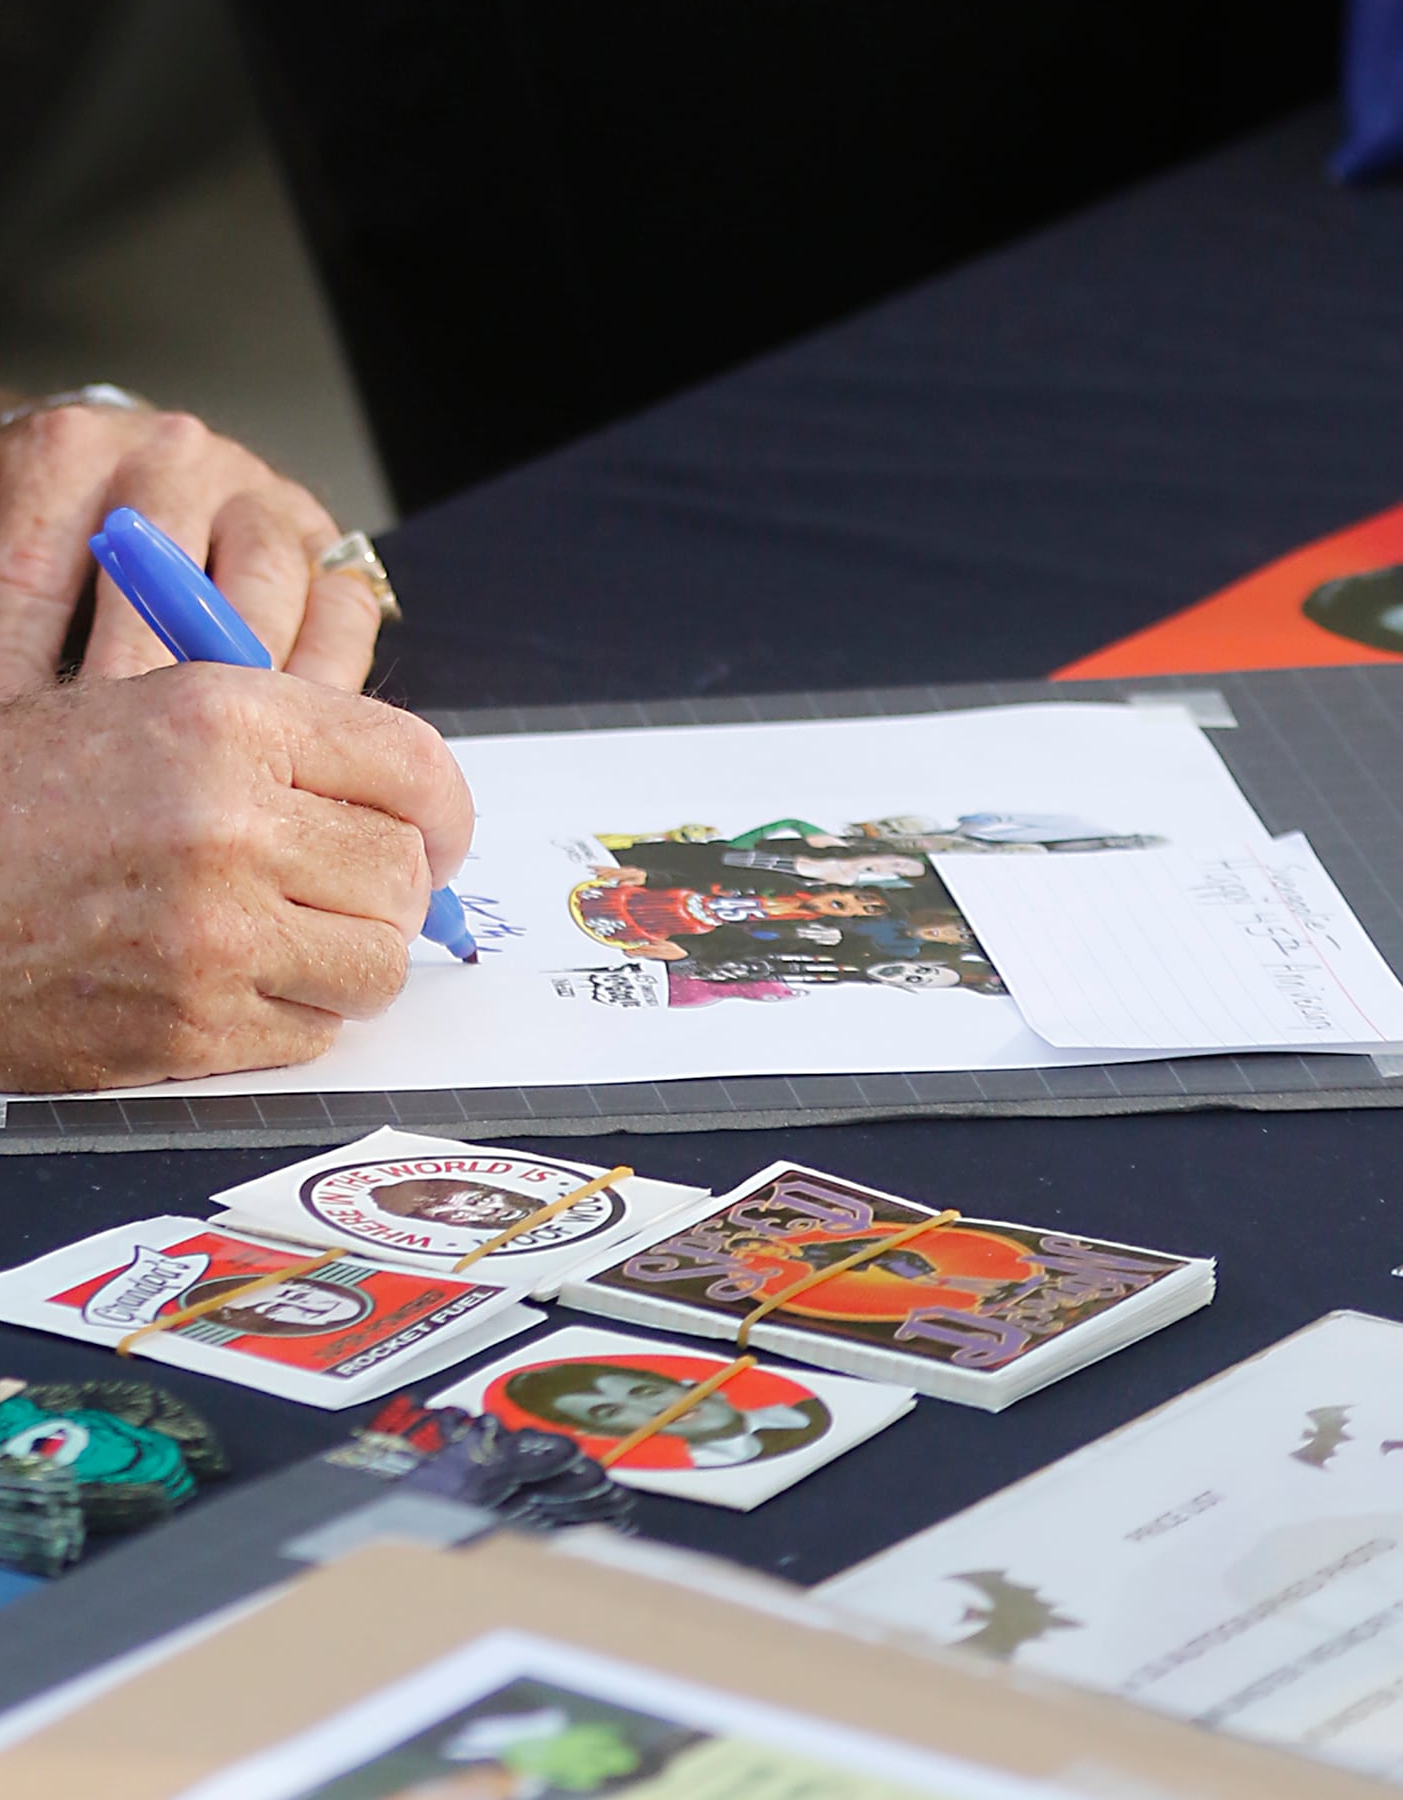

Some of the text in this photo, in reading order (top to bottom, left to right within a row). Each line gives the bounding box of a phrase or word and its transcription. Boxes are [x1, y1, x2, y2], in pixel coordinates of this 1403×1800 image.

[316, 1160, 559, 1248] WHERE IN THE WORLD IS
[92, 1256, 192, 1324] Grandpa's
[336, 1286, 496, 1379] ROCKET FUEL
